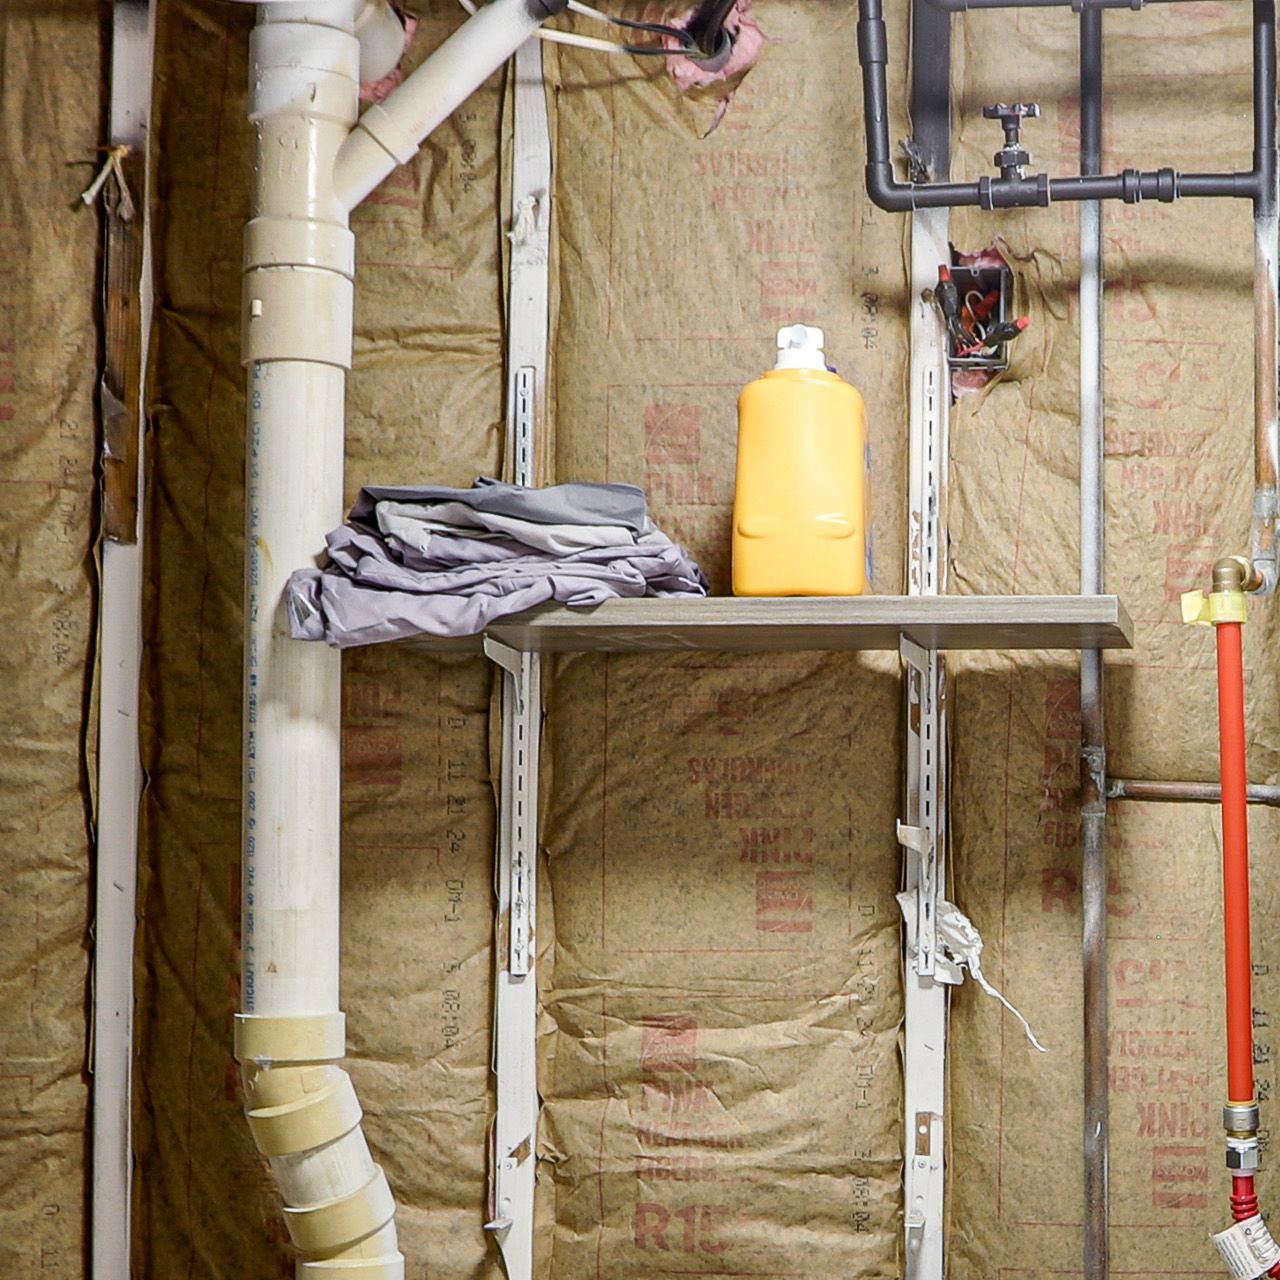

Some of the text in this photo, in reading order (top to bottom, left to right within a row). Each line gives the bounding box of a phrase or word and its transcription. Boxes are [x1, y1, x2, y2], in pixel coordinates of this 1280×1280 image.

[446, 830, 466, 854] 24
[1136, 1101, 1211, 1139] PINK
[634, 1202, 732, 1255] R15
[40, 1249, 61, 1270] 11
